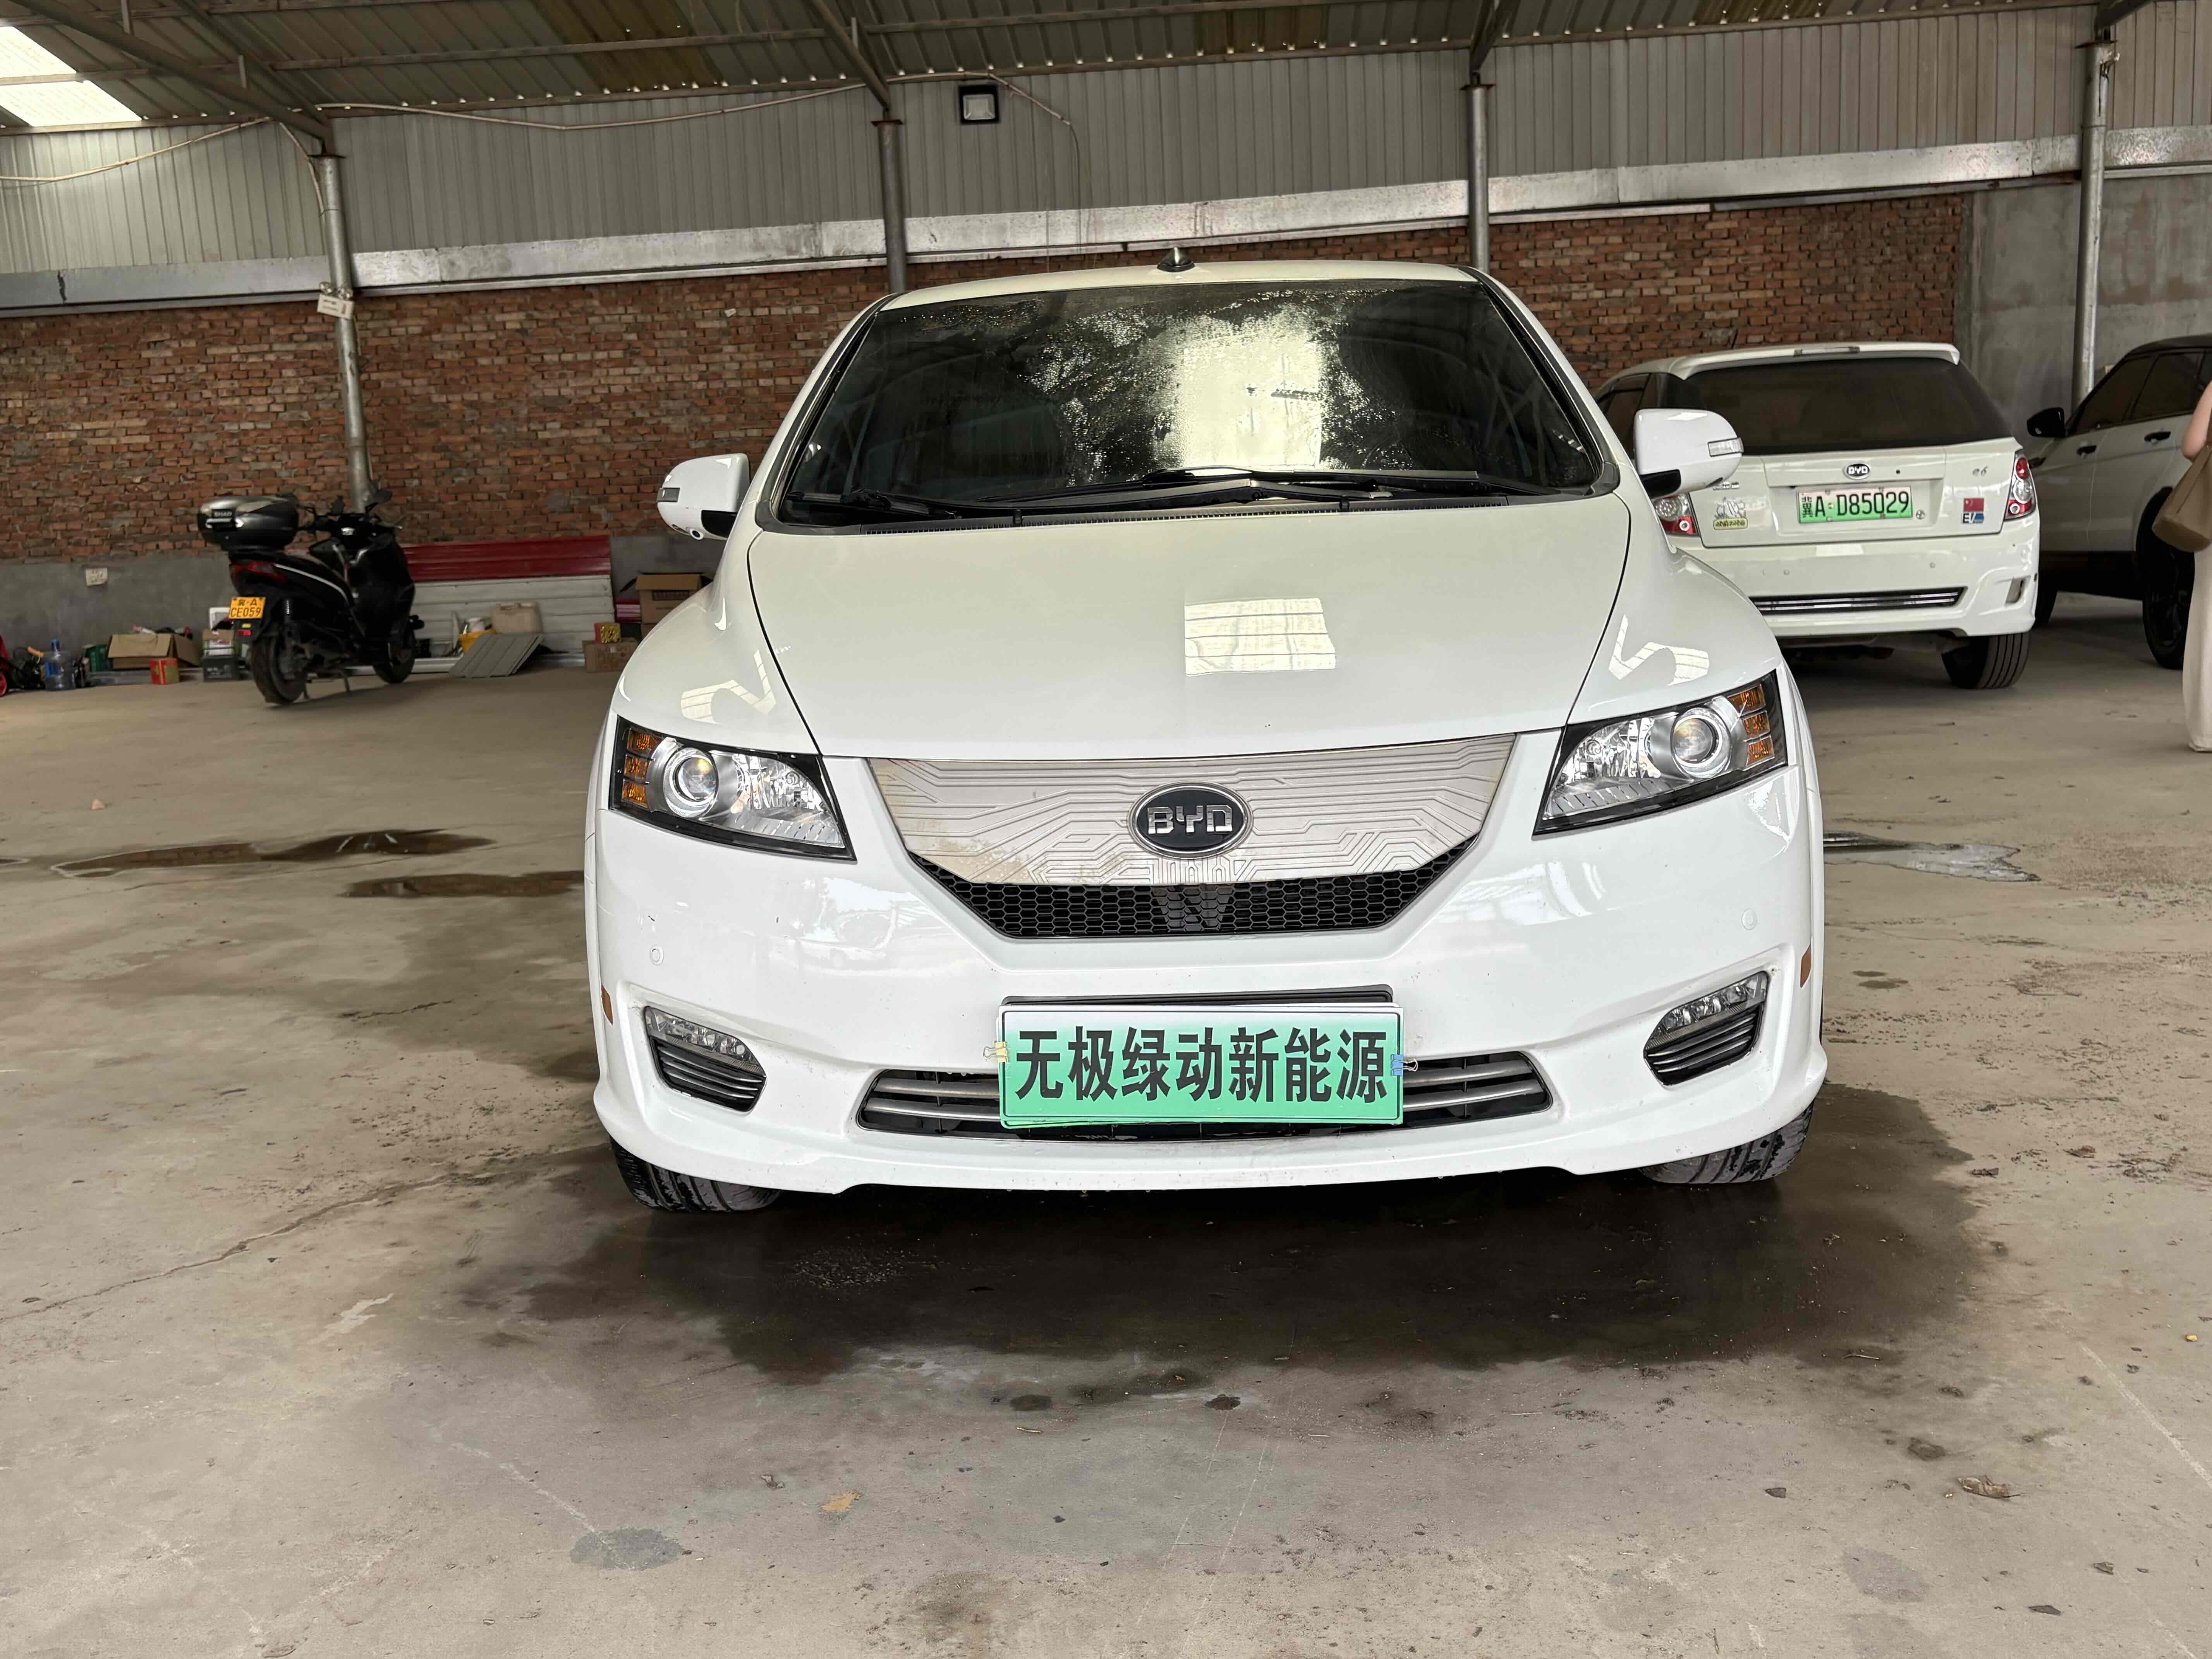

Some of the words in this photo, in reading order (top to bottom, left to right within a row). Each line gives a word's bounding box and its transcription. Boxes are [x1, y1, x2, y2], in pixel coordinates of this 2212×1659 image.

[1848, 466, 1868, 474] BYD
[231, 607, 261, 617] CE059
[1147, 805, 1232, 834] BYD
[1015, 1026, 1387, 1103] 无极绿动新能源
